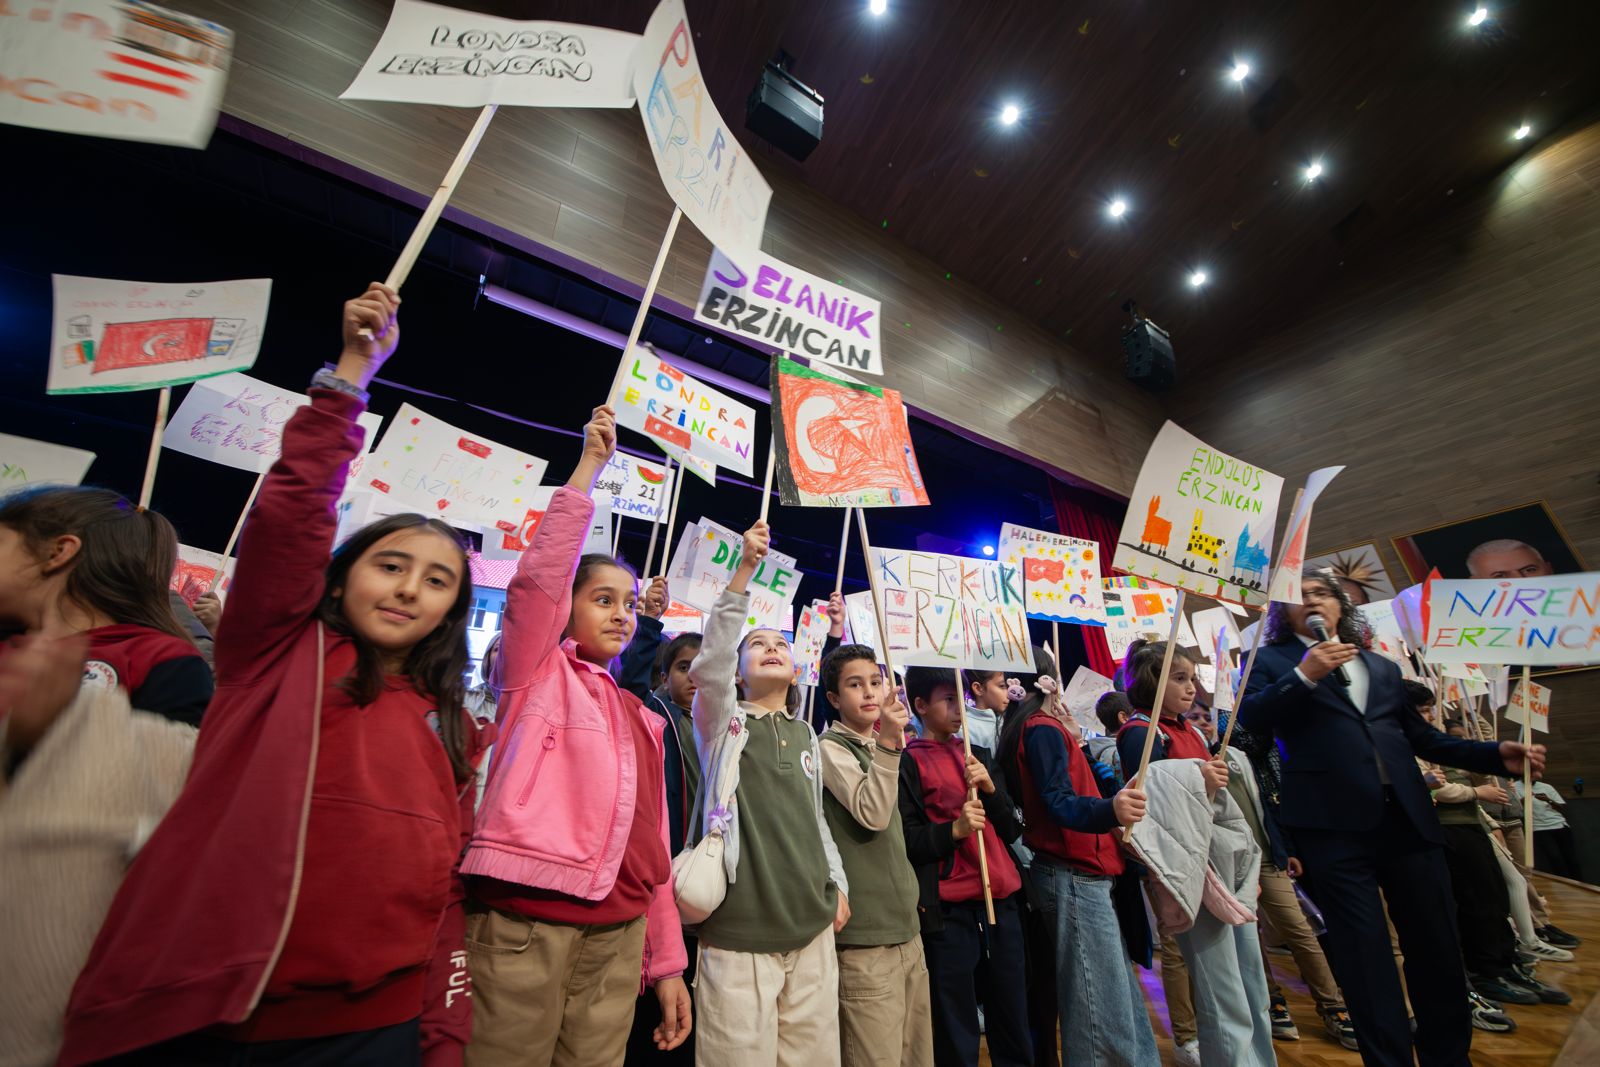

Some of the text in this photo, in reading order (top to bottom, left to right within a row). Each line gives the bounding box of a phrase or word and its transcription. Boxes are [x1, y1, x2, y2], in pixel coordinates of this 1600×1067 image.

[430, 25, 586, 56] LONDRA
[702, 286, 871, 370] ERZİNCAN
[623, 386, 750, 459] ERZİNCAN
[631, 359, 748, 430] LONDRA
[638, 484, 655, 501] 21
[879, 552, 1023, 606] KERKÜK
